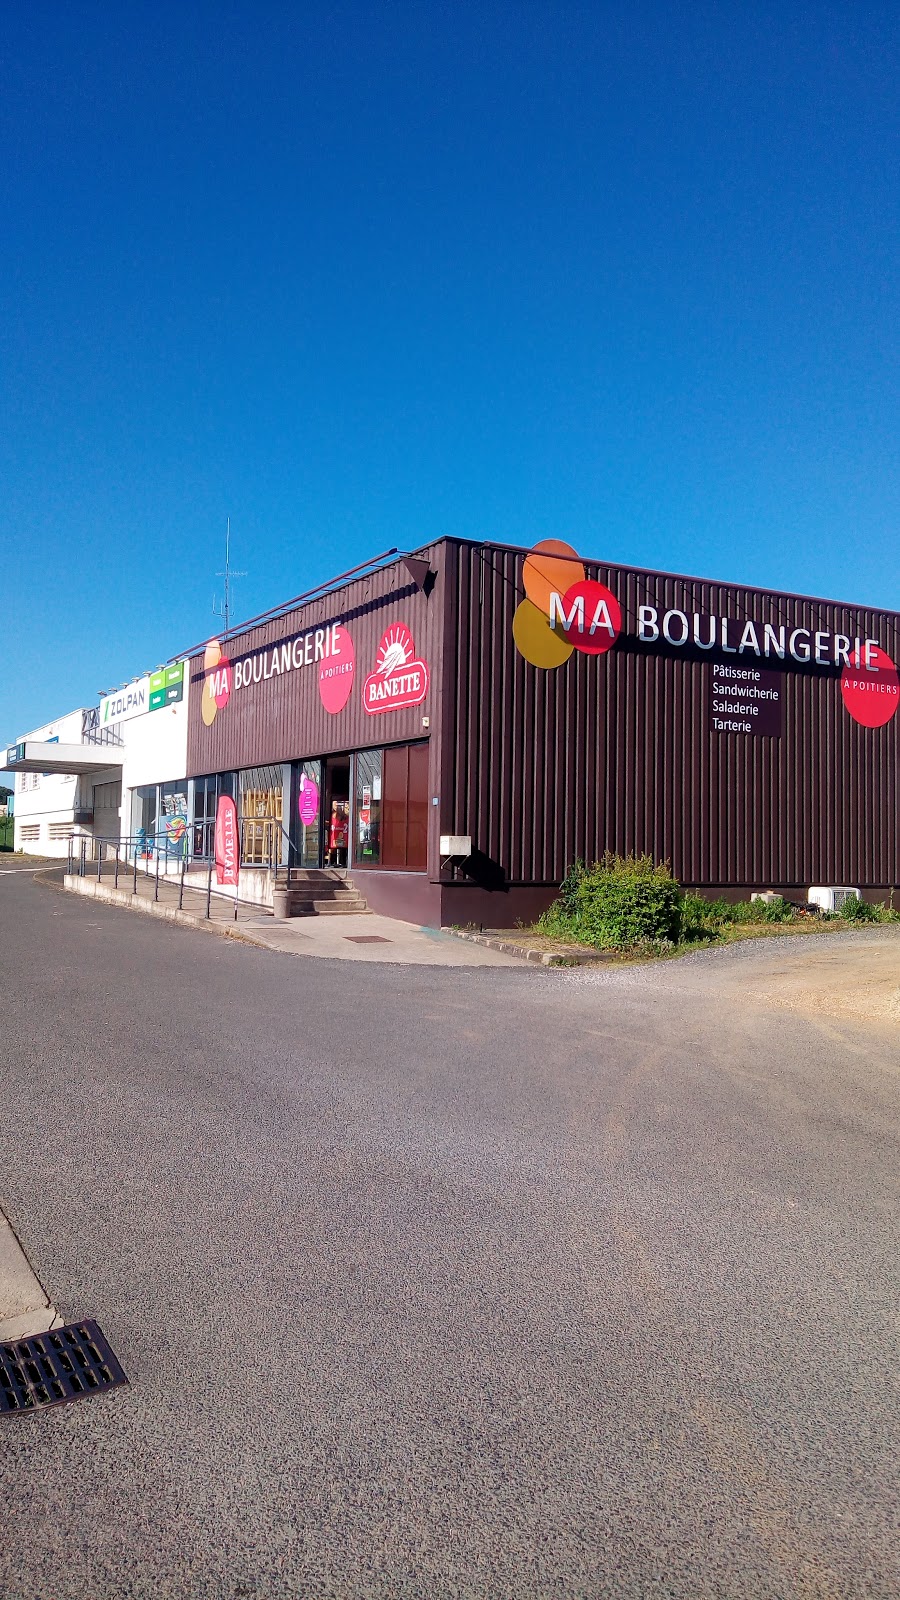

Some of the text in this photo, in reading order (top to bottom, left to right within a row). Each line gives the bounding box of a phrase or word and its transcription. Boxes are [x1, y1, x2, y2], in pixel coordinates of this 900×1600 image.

[549, 591, 880, 672] MA BOULANGERIE
[209, 622, 342, 698] MA BOULANGERIE
[325, 662, 353, 679] POITIERS
[713, 664, 761, 681] Pâtisserie
[368, 672, 421, 702] BANETTE
[712, 682, 779, 701] Sandwicherie
[843, 677, 897, 695] À POITIERS
[111, 689, 145, 717] ZOLPAN
[712, 700, 759, 716] Saladerie
[712, 717, 752, 732] Tarterie
